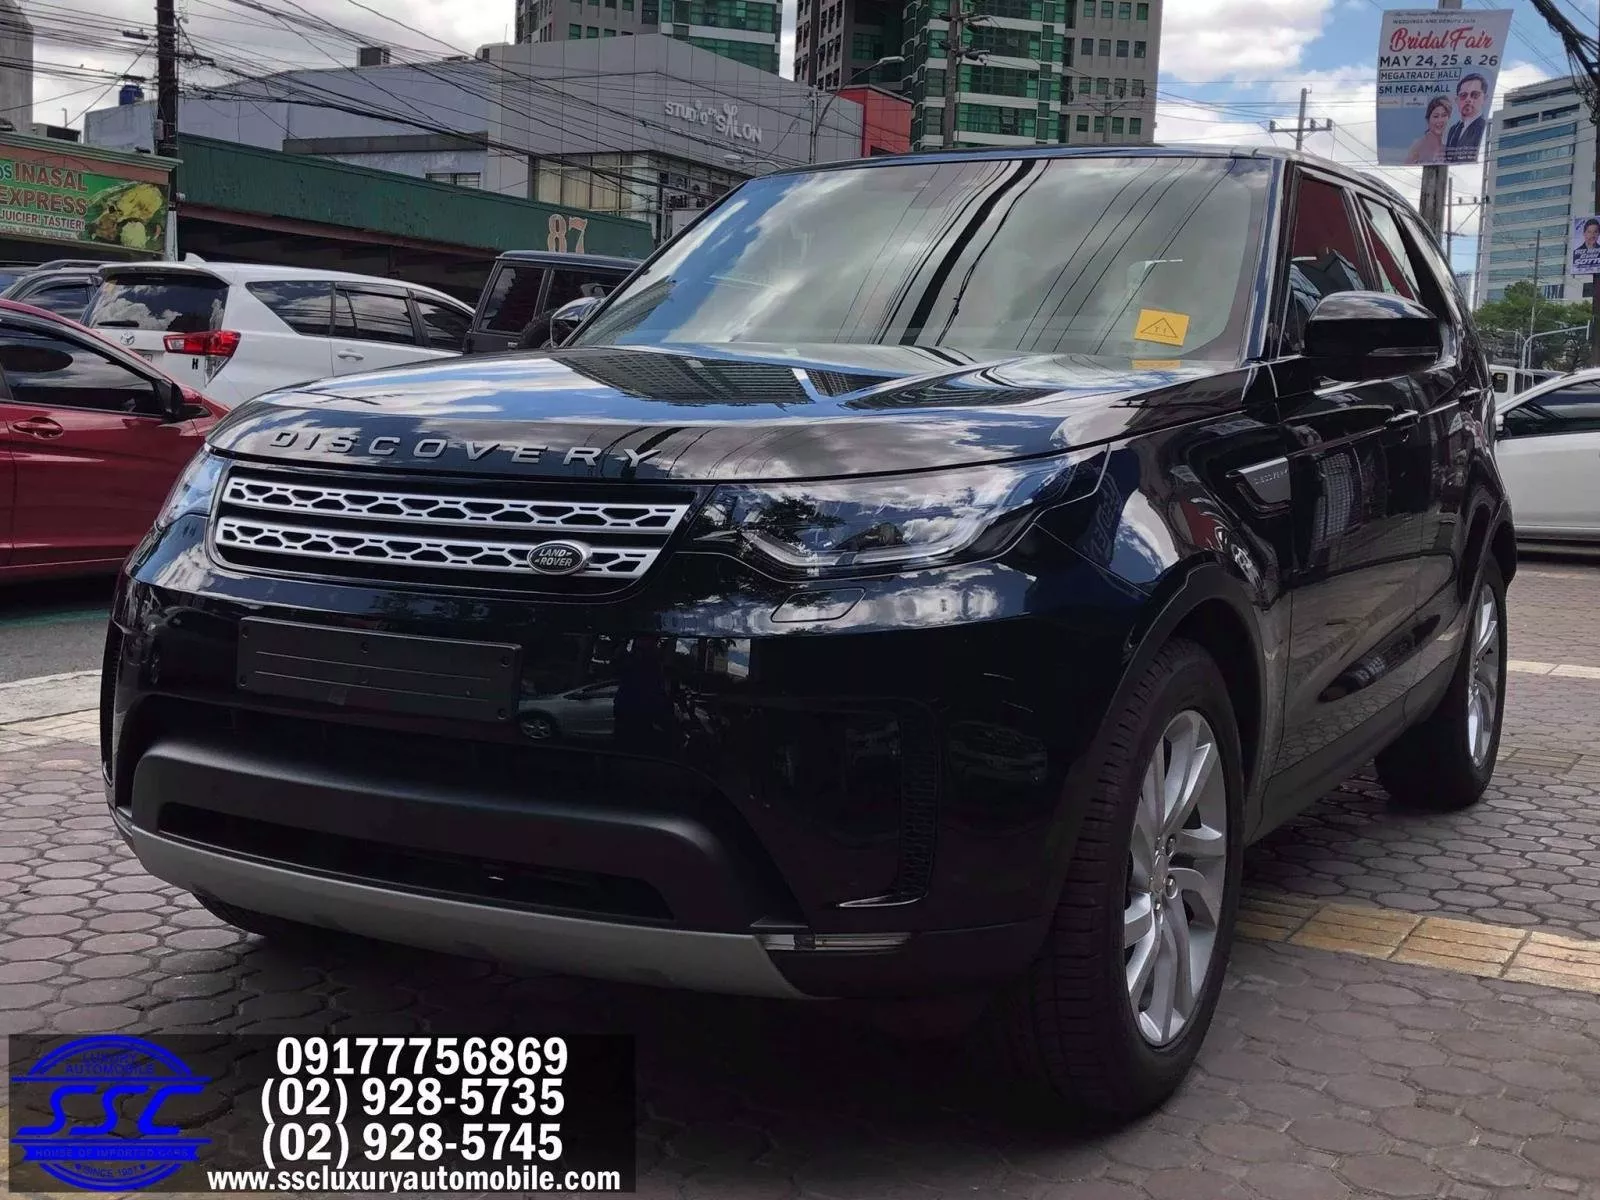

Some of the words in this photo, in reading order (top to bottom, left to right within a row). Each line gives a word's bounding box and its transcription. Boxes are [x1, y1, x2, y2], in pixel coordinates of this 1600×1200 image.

[1390, 27, 1450, 52] Bridal
[1450, 26, 1494, 52] Fair
[1380, 56, 1411, 67] MAY
[1416, 55, 1437, 68] 24,
[1441, 54, 1458, 65] 25
[1464, 56, 1472, 65] &
[1478, 54, 1498, 66] 26
[1381, 71, 1435, 80] MEGATRADE
[1437, 70, 1459, 79] HALL
[1379, 86, 1392, 94] SM
[1395, 85, 1450, 93] MEGAMALL
[15, 162, 88, 192] INASAL
[0, 186, 87, 216] EXPRESS
[43, 215, 85, 231] TASTIER!
[547, 213, 588, 255] 87
[270, 430, 661, 467] DISCOVERY
[539, 548, 567, 557] LAND
[539, 557, 573, 566] ROVER
